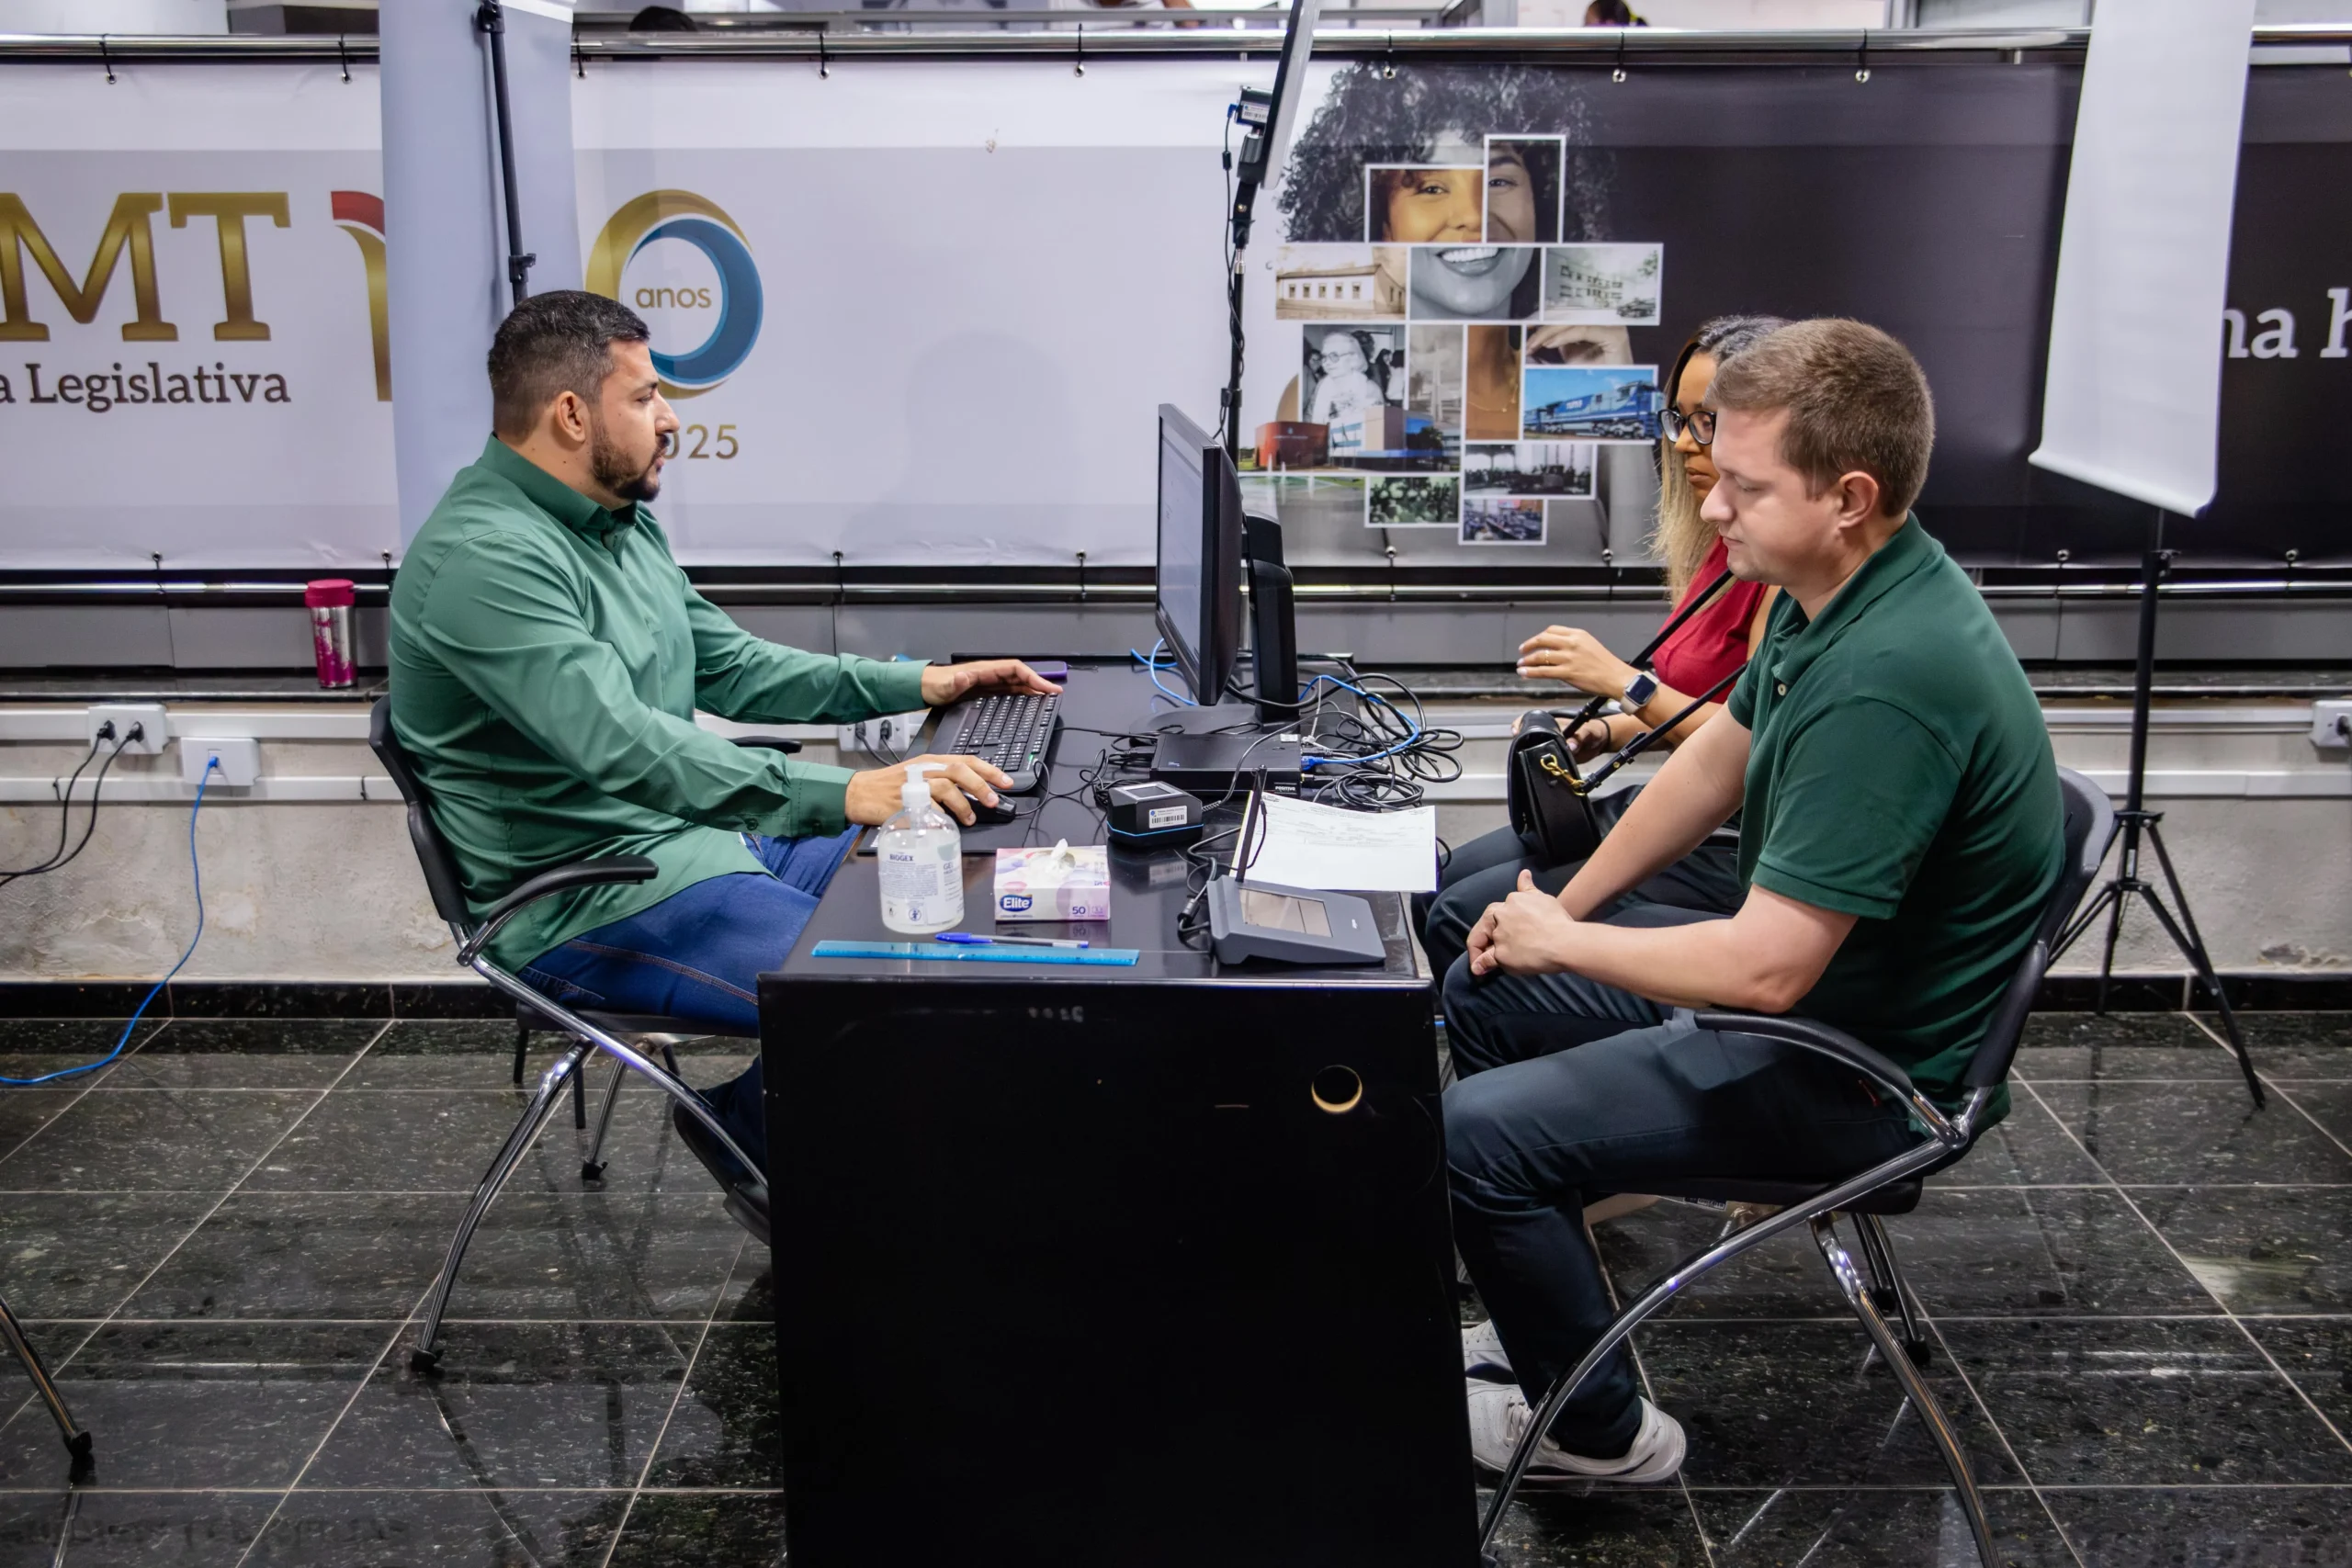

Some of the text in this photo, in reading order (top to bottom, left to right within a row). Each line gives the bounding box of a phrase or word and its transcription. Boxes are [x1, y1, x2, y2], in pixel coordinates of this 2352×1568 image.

[635, 287, 712, 310] anos
[25, 362, 291, 413] Legislativa
[889, 853, 914, 862] BIOGEX
[1002, 897, 1030, 909] Elite
[1072, 906, 1086, 915] 50
